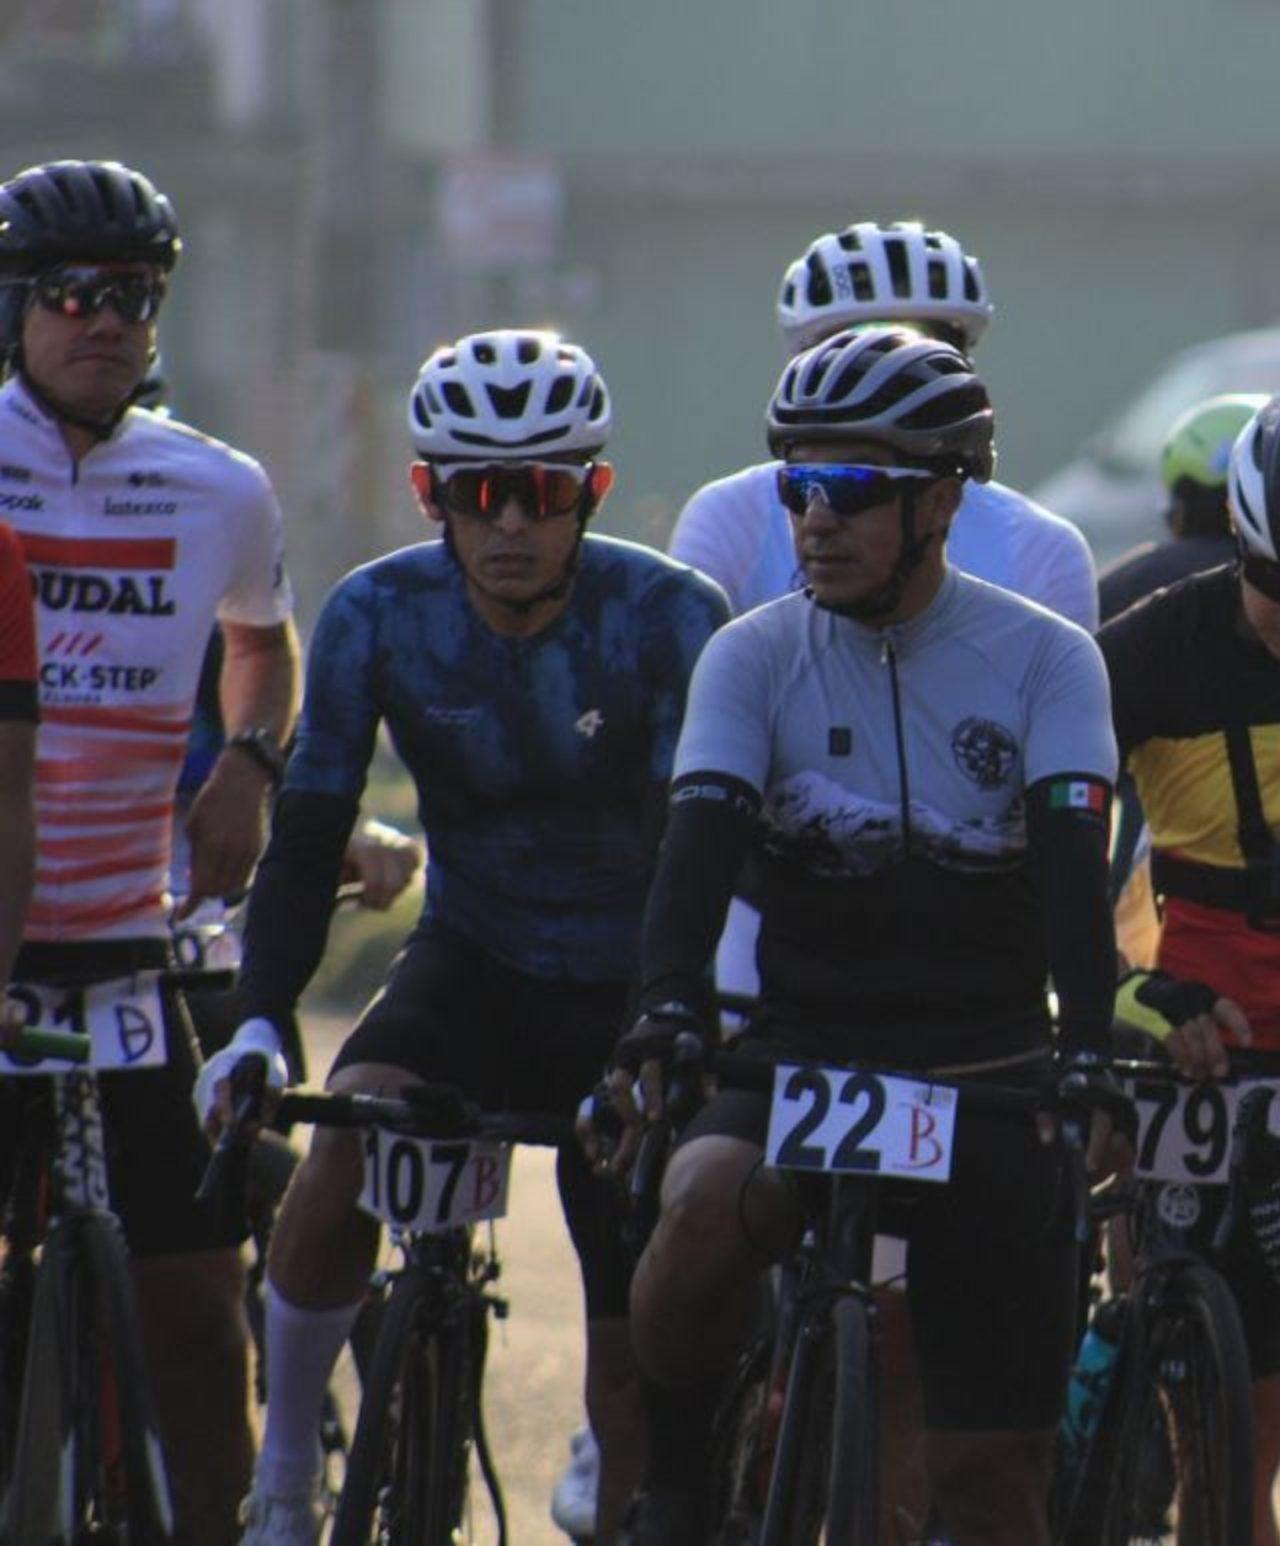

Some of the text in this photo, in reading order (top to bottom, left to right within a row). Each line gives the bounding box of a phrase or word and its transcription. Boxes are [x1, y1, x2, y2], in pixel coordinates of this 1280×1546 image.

[32, 572, 175, 616] UDAL
[776, 1069, 943, 1171] 22 B
[1134, 1081, 1229, 1176] 79
[366, 1130, 469, 1223] 107
